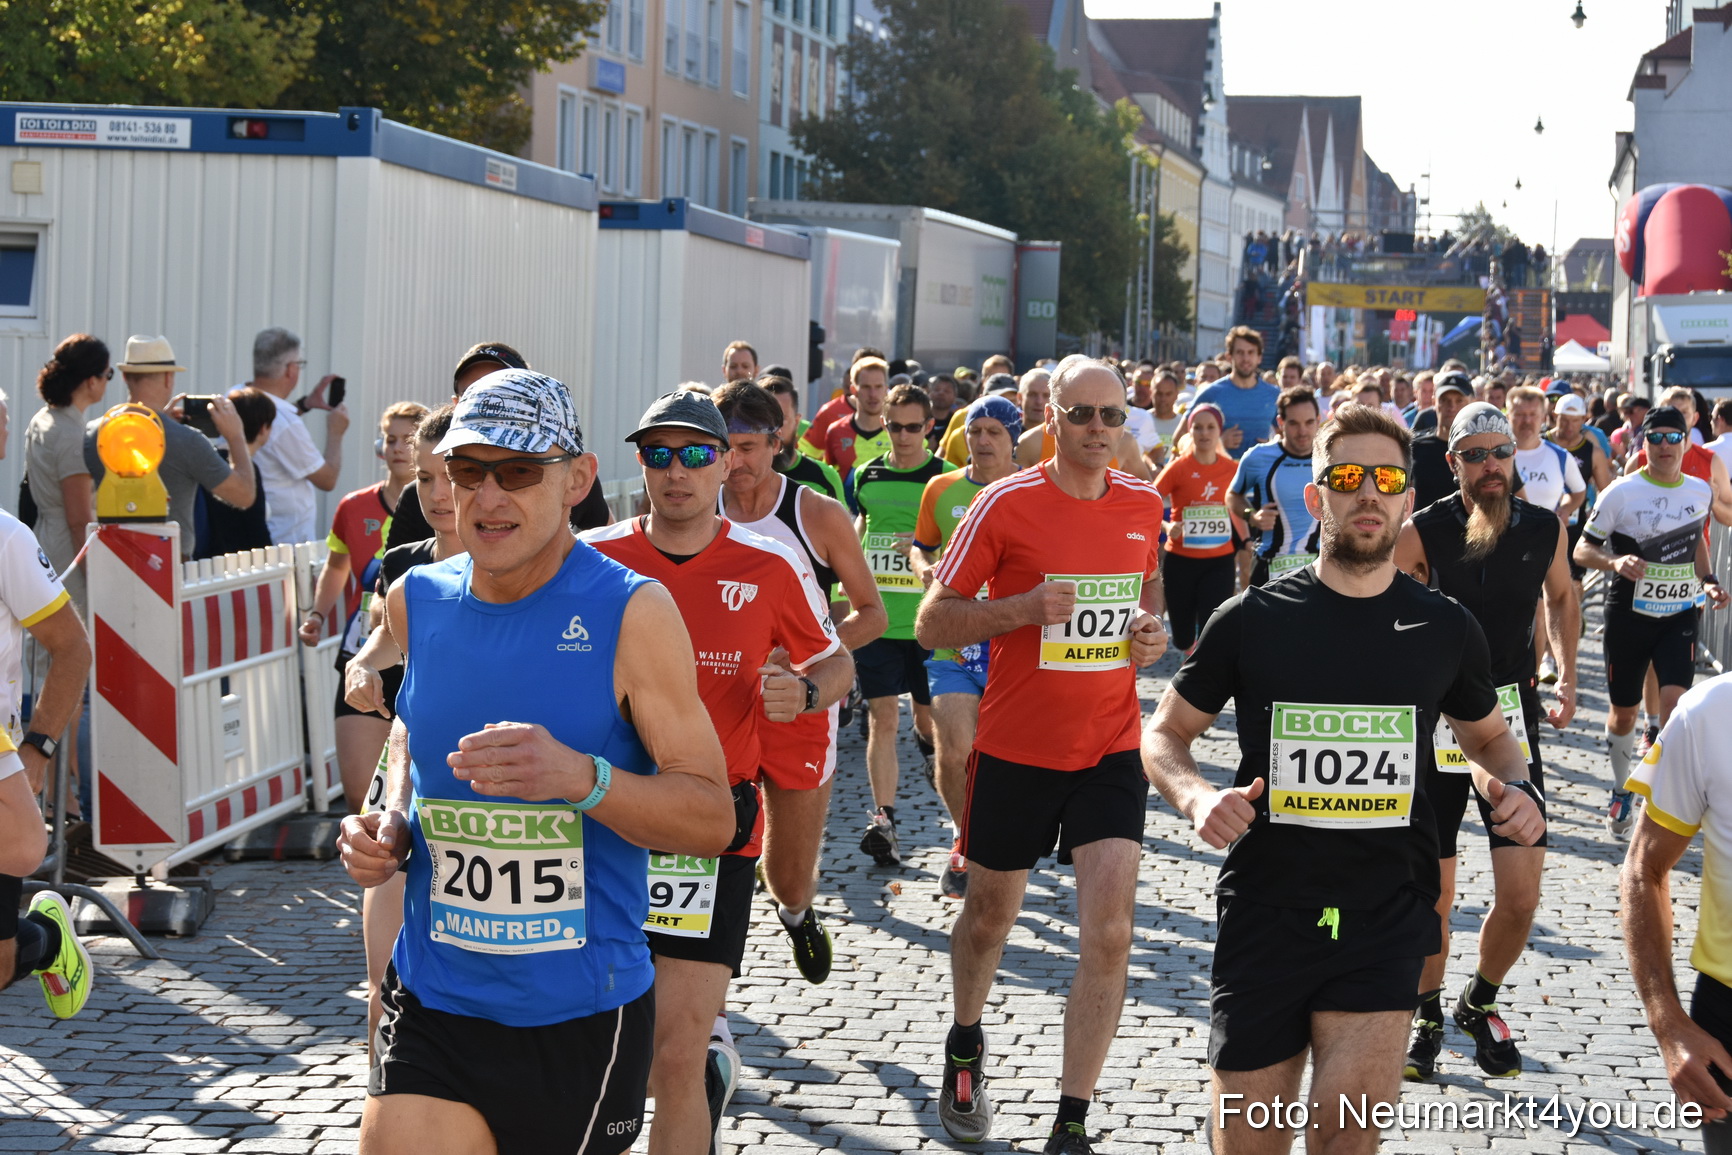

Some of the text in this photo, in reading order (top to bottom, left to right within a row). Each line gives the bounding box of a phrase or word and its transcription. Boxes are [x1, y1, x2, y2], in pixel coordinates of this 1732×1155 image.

[22, 119, 95, 131] TOI TOI & DIXI
[1365, 289, 1426, 305] START
[1189, 521, 1226, 534] 2799
[1126, 532, 1145, 541] adidas
[1645, 565, 1692, 579] BOCK
[1076, 579, 1135, 600] OCK
[1642, 582, 1690, 600] 2648
[1645, 602, 1683, 611] GÜNTER
[1064, 608, 1131, 638] 1027
[556, 642, 592, 652] odlo
[1064, 646, 1120, 660] ALFRED
[699, 650, 742, 663] WALTER
[701, 660, 740, 669] HERRENHAUS
[714, 667, 738, 676] Lauf
[1283, 709, 1404, 739] BOCK
[1289, 749, 1398, 785] 1024
[1284, 796, 1397, 811] ALEXANDER
[429, 804, 569, 844] BOCK
[650, 854, 705, 873] CK
[443, 850, 565, 904] 2015
[649, 881, 699, 909] 97
[445, 911, 562, 941] MANFRED
[646, 913, 683, 927] ERT
[607, 1118, 638, 1136] GORE
